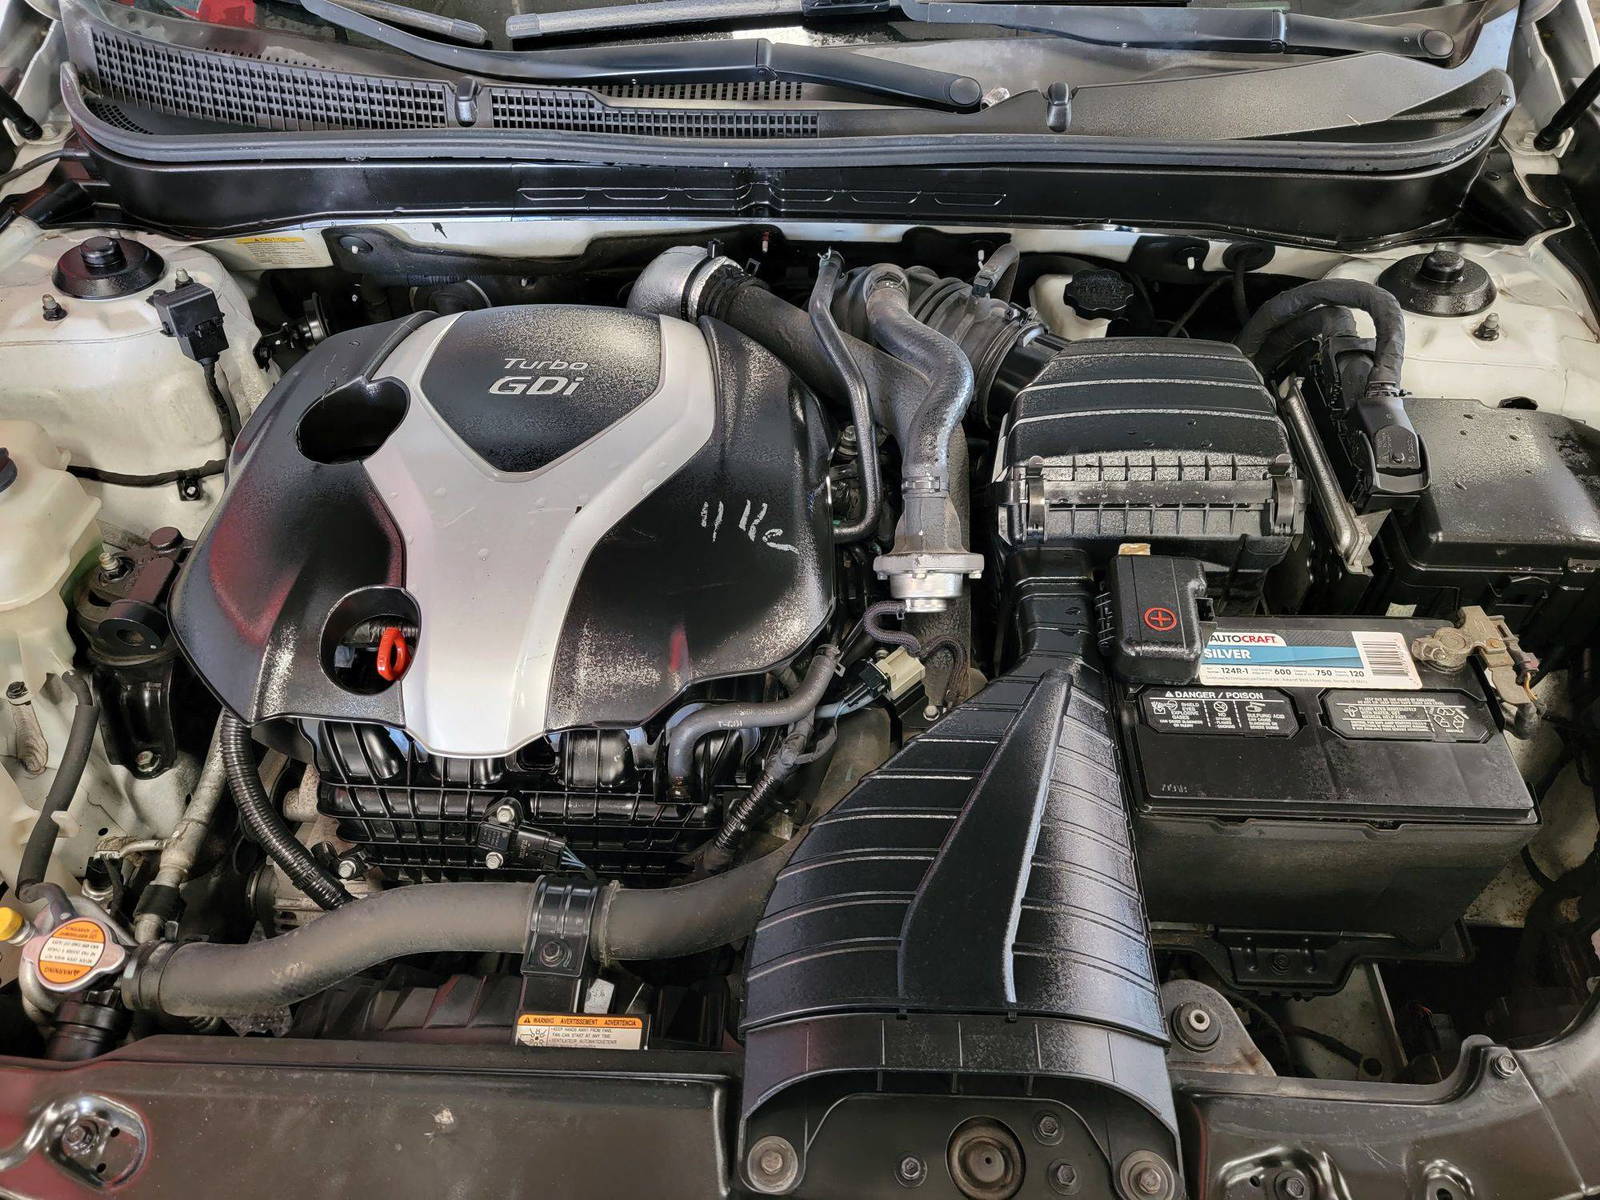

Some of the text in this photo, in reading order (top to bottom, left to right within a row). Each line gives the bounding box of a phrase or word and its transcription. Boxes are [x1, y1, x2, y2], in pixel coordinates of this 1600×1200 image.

[504, 358, 589, 370] Turbo
[489, 376, 585, 396] GDi
[1209, 635, 1277, 644] AUTOCRAFT
[1204, 648, 1252, 660] SILVER
[1221, 667, 1249, 675] 124R-1
[1274, 668, 1292, 676] 600
[1316, 669, 1333, 677] 750
[1349, 670, 1365, 678] 120
[1174, 691, 1216, 699] DANGER
[1226, 692, 1264, 700] POISON
[44, 967, 75, 976] WARNING
